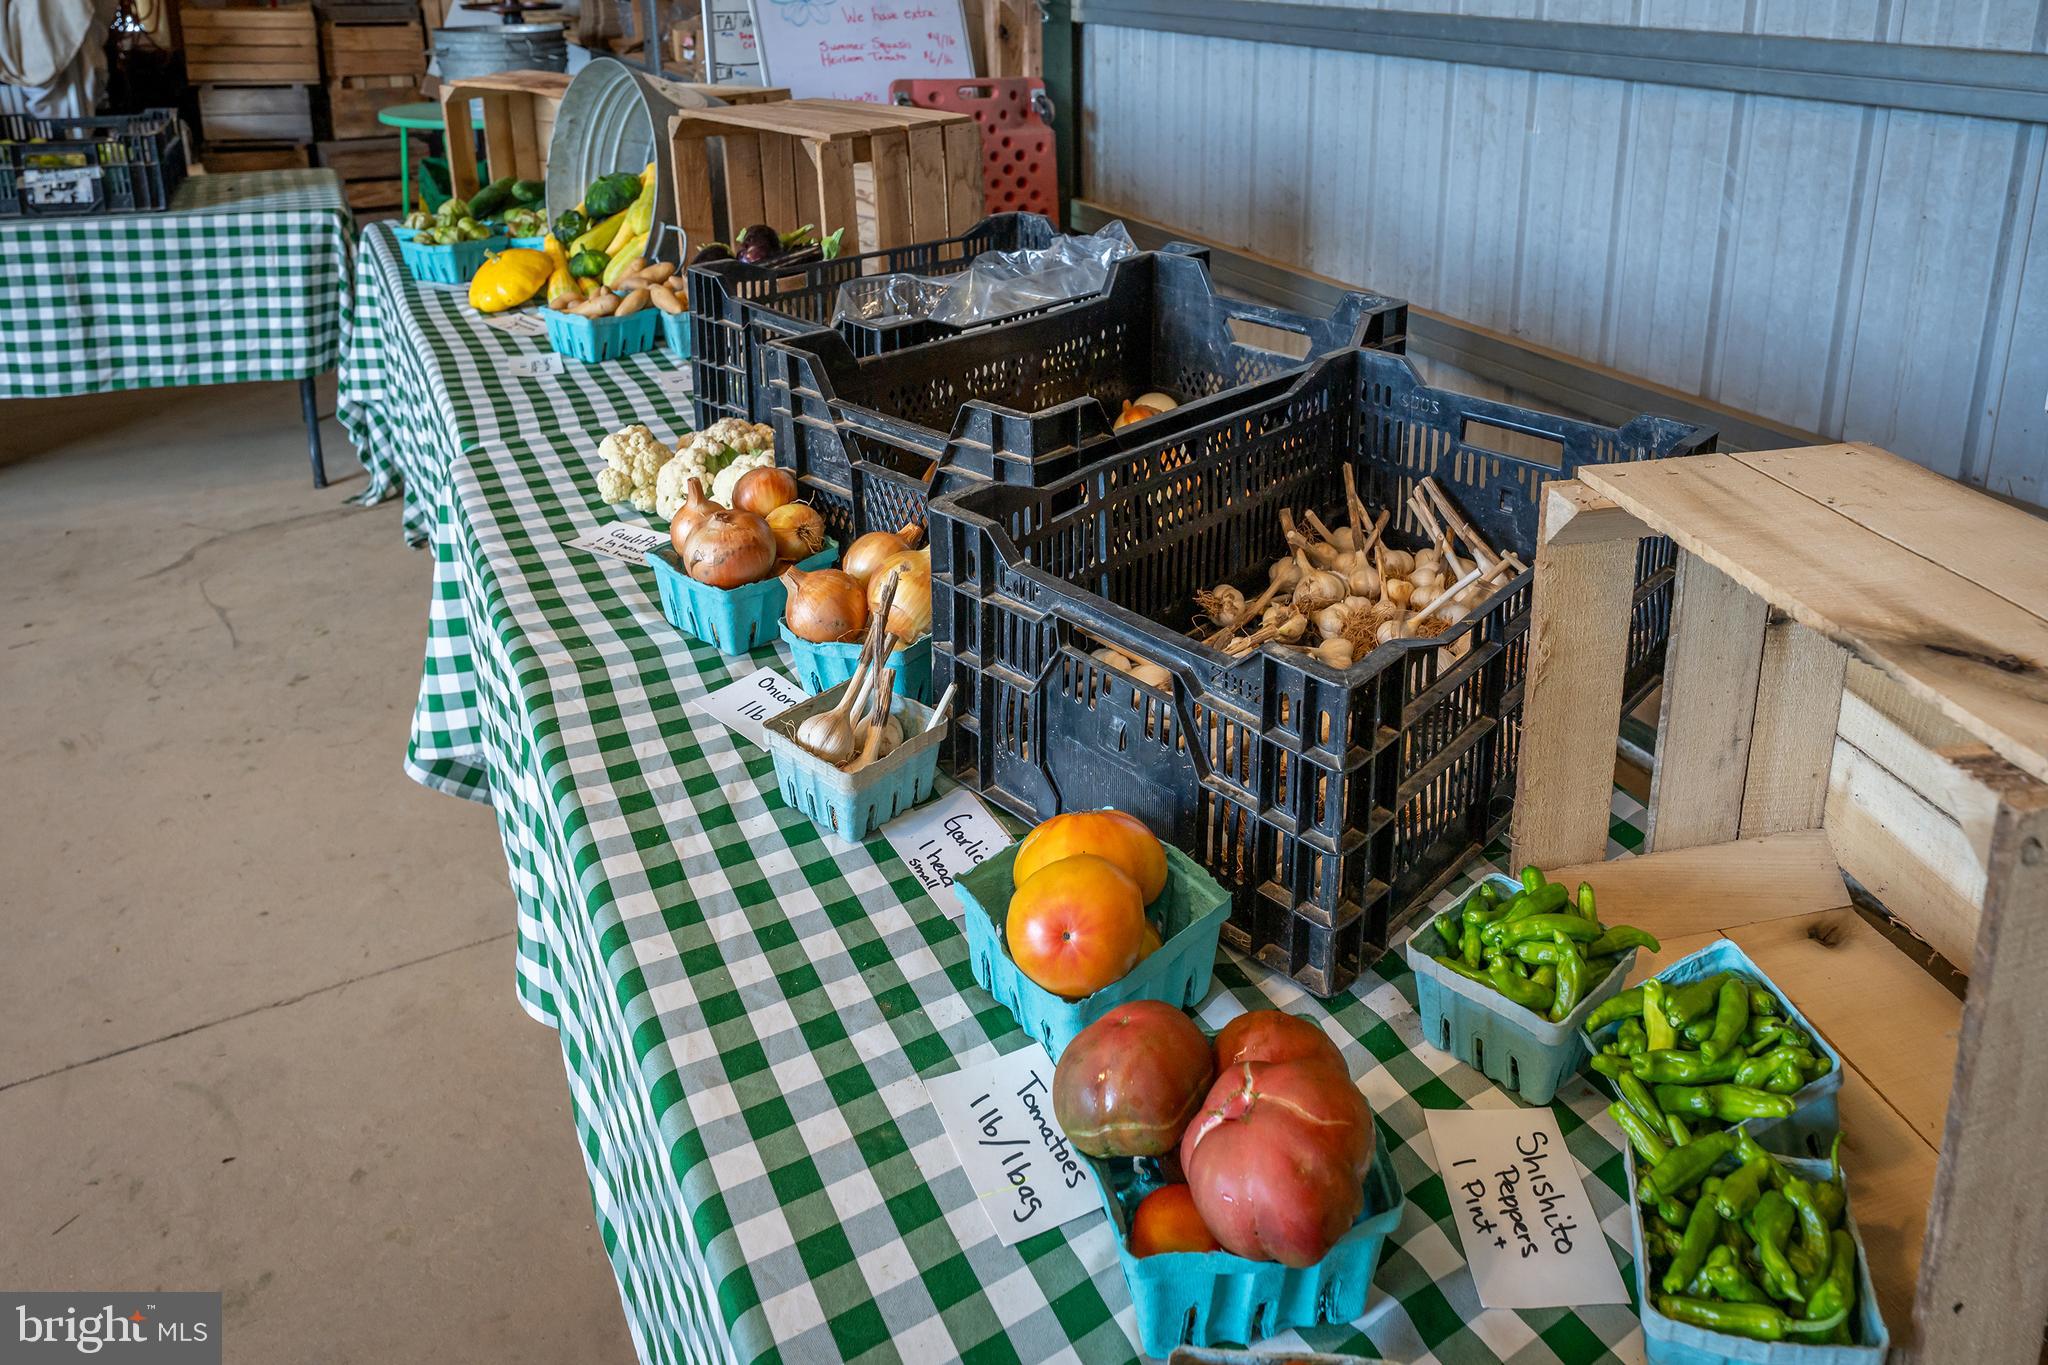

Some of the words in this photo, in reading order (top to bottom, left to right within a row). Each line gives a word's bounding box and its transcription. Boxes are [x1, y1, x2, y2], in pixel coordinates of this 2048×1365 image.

[841, 6, 864, 23] We
[871, 5, 898, 20] have
[903, 8, 935, 20] extra
[918, 839, 935, 850] 1
[943, 813, 989, 865] Garlic
[908, 857, 941, 891] small
[1016, 1069, 1087, 1190] Tomatoes
[1452, 1158, 1477, 1168] 1
[1460, 1178, 1498, 1235] Pint
[1493, 1163, 1539, 1259] Peppers
[1515, 1131, 1578, 1255] Shishito
